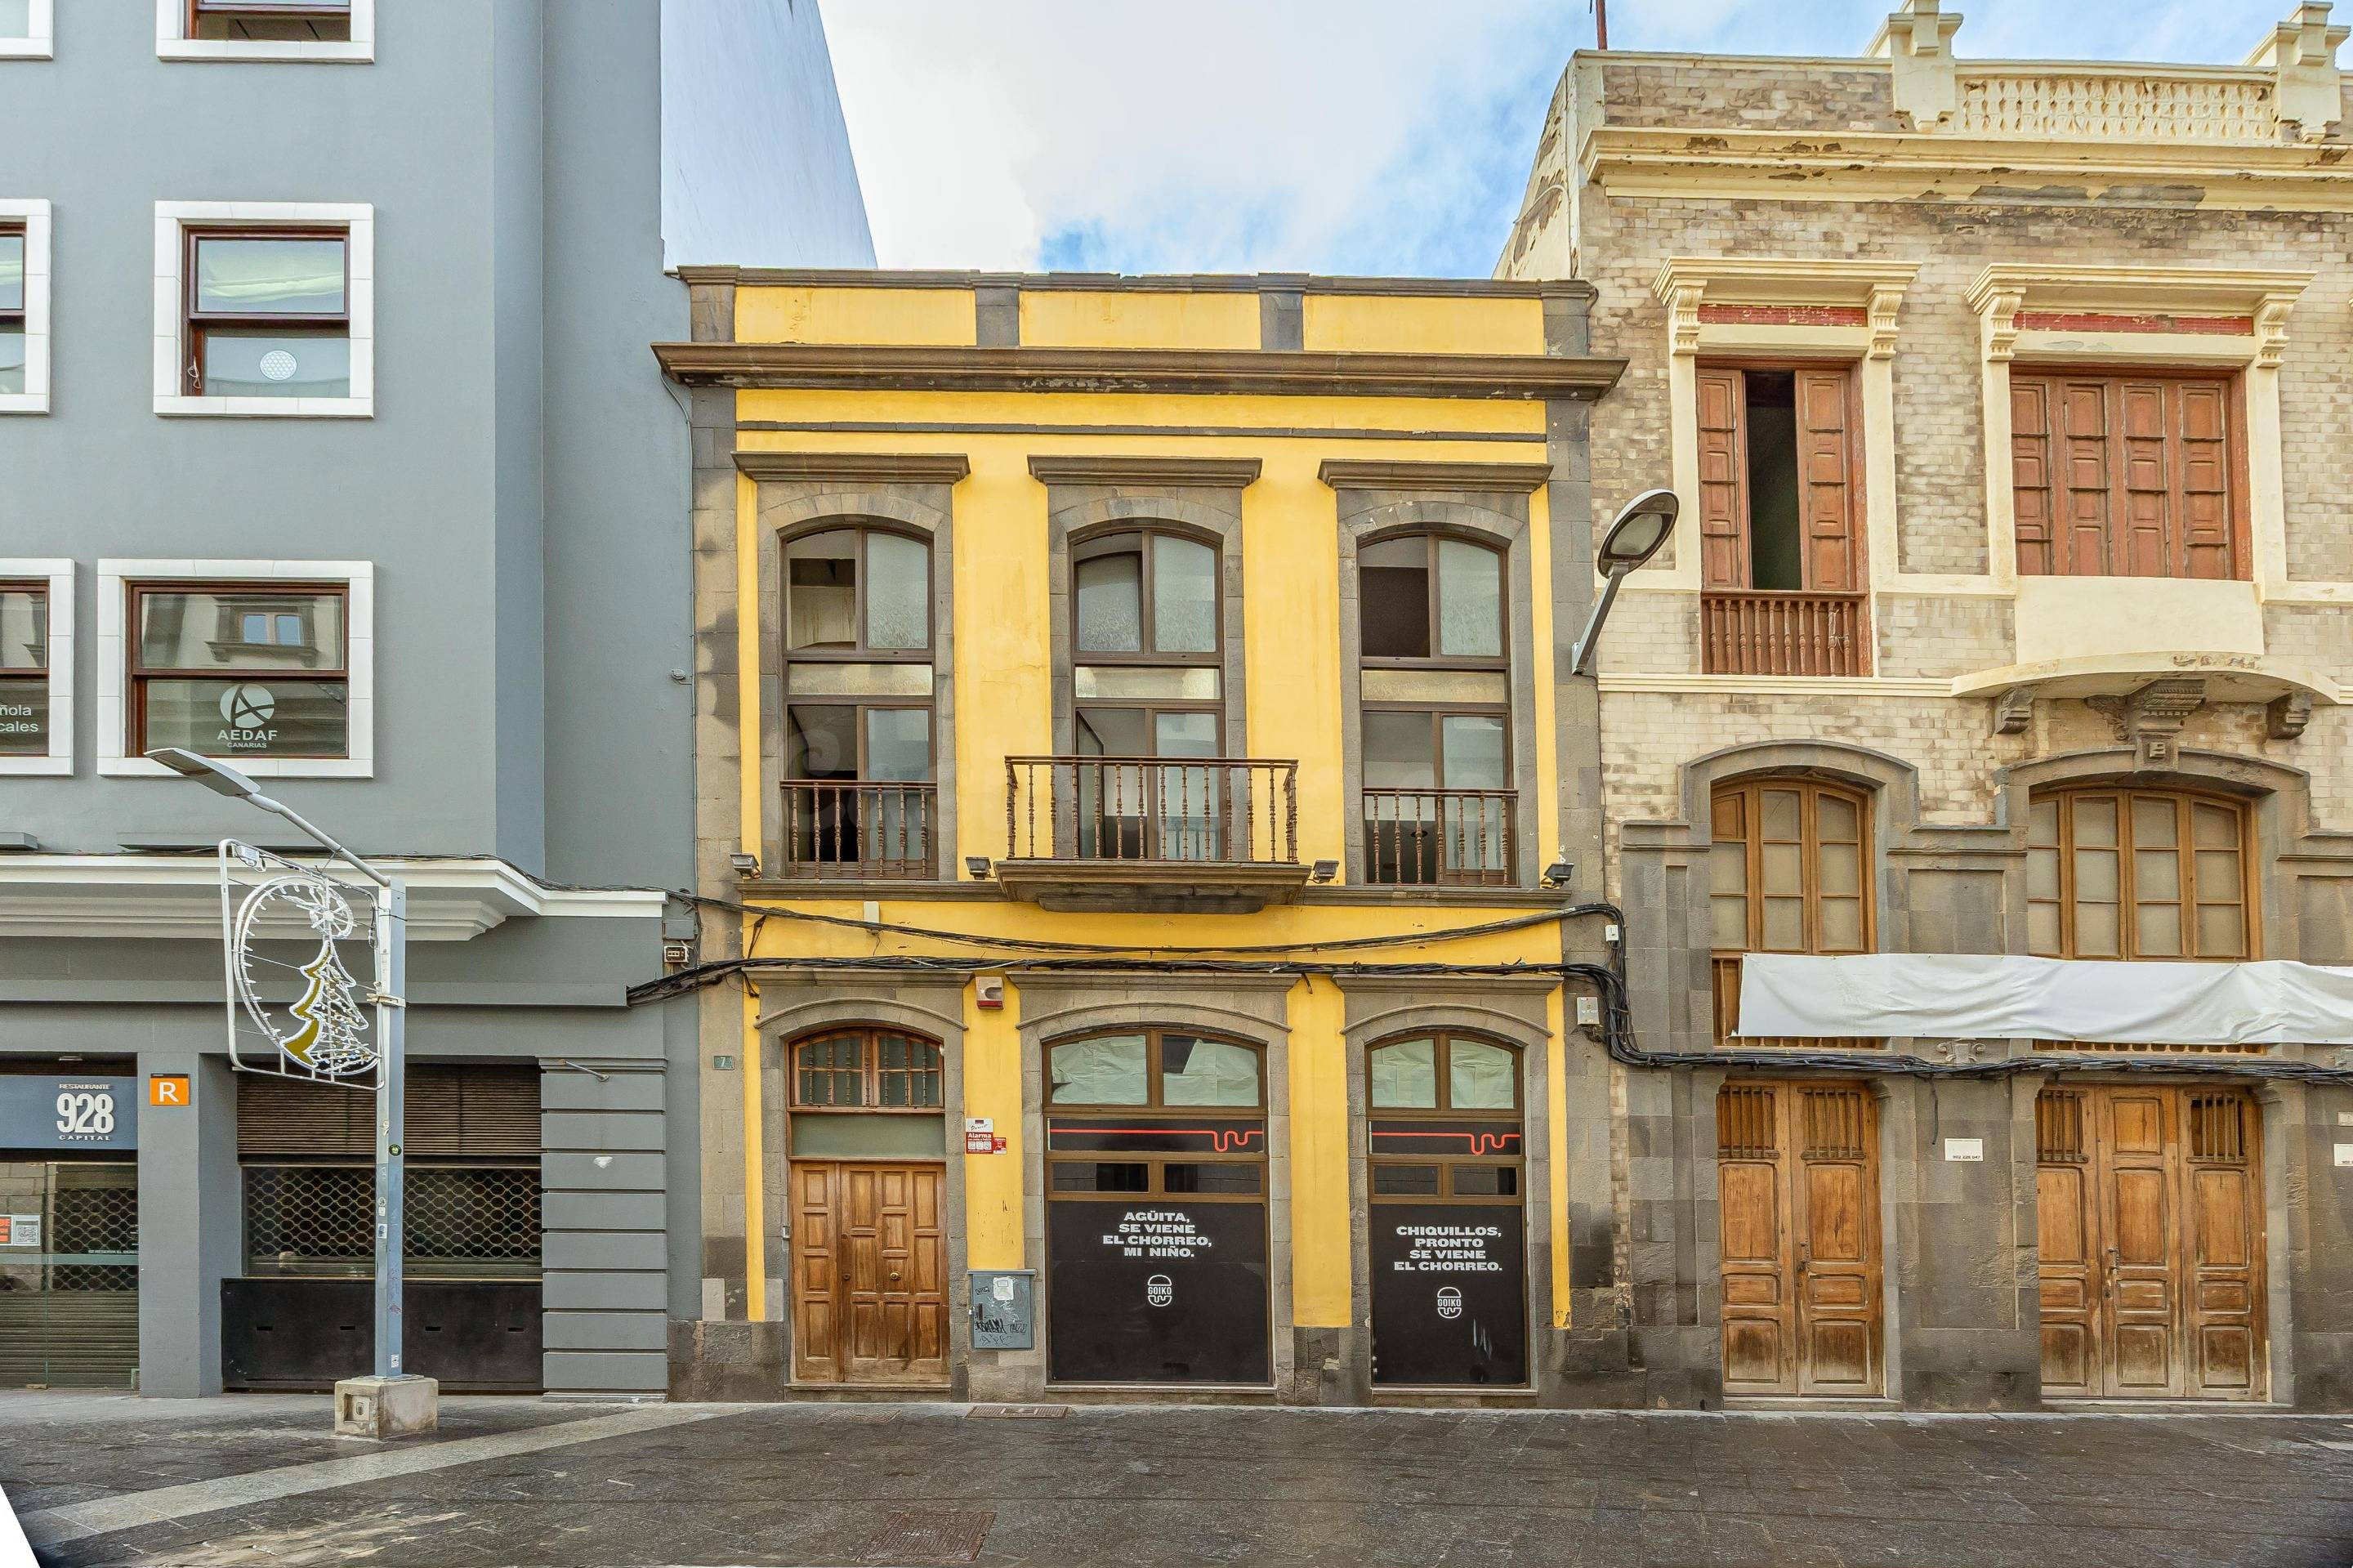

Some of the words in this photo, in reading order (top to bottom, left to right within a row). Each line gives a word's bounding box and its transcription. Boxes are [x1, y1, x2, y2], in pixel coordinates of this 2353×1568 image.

[217, 730, 278, 741] AEDAF
[721, 1057, 726, 1067] 7
[159, 1082, 179, 1102] R
[56, 1092, 114, 1134] 928
[1123, 1210, 1190, 1223] AGÜITA,
[1118, 1223, 1141, 1233] SE
[1144, 1224, 1195, 1234] VIENE
[1395, 1226, 1502, 1238] CHIQUILLOS,
[1102, 1235, 1125, 1244] EL
[1127, 1235, 1212, 1248] CHORREO,
[1414, 1238, 1485, 1248] PRONTO
[1123, 1247, 1142, 1257] MI
[1149, 1245, 1194, 1258] NIÑO.
[1409, 1249, 1432, 1259] SE
[1434, 1249, 1487, 1259] VIENE
[1394, 1262, 1416, 1271] EL
[1418, 1262, 1503, 1271] CHORREO.
[1148, 1286, 1172, 1295] GOIKO
[1437, 1298, 1462, 1307] GOIKO
